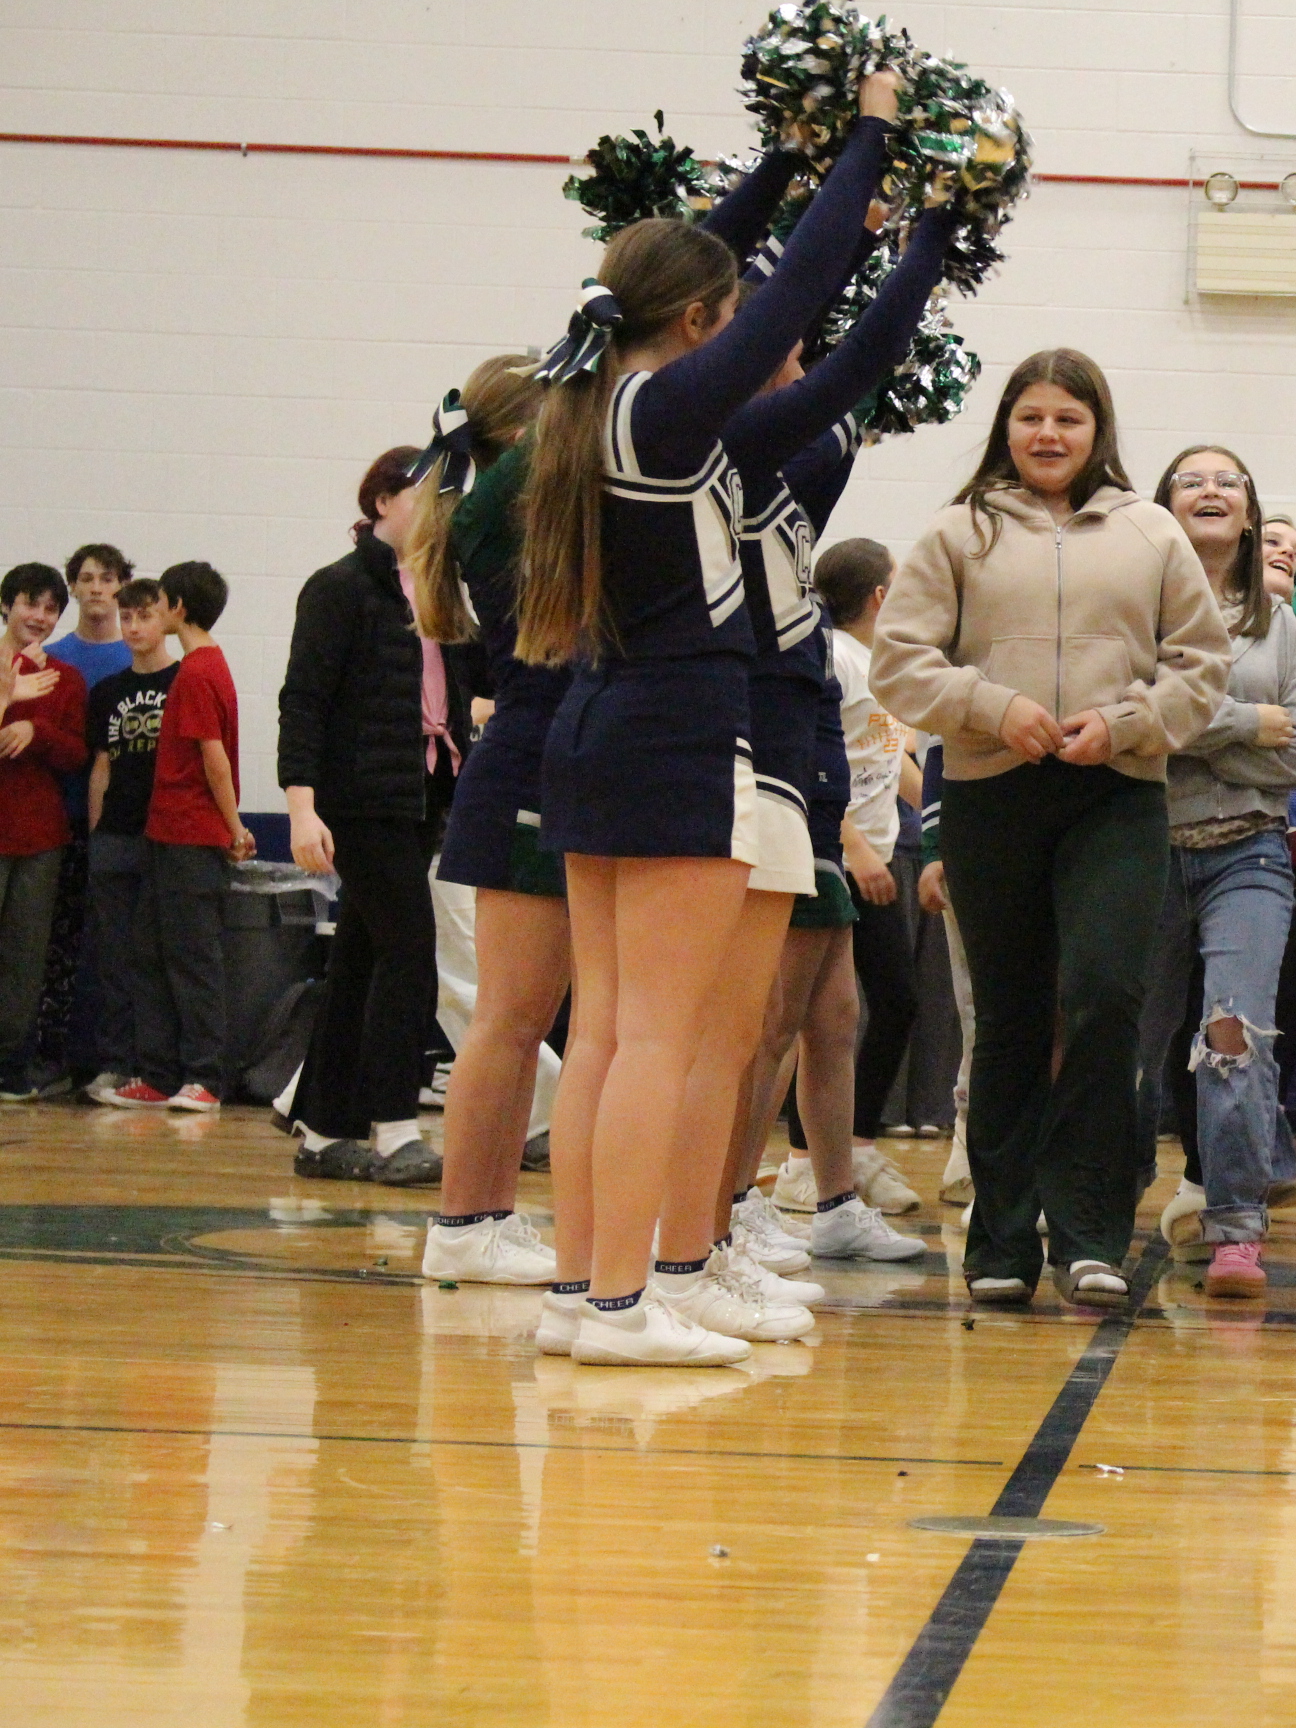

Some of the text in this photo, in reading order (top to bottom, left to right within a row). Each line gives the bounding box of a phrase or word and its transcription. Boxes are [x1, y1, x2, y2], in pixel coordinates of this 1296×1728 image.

[108, 689, 167, 743] THE BLACK
[660, 1264, 692, 1272] CHEER
[560, 1282, 588, 1292] CHEE
[592, 1297, 634, 1309] CHEER
